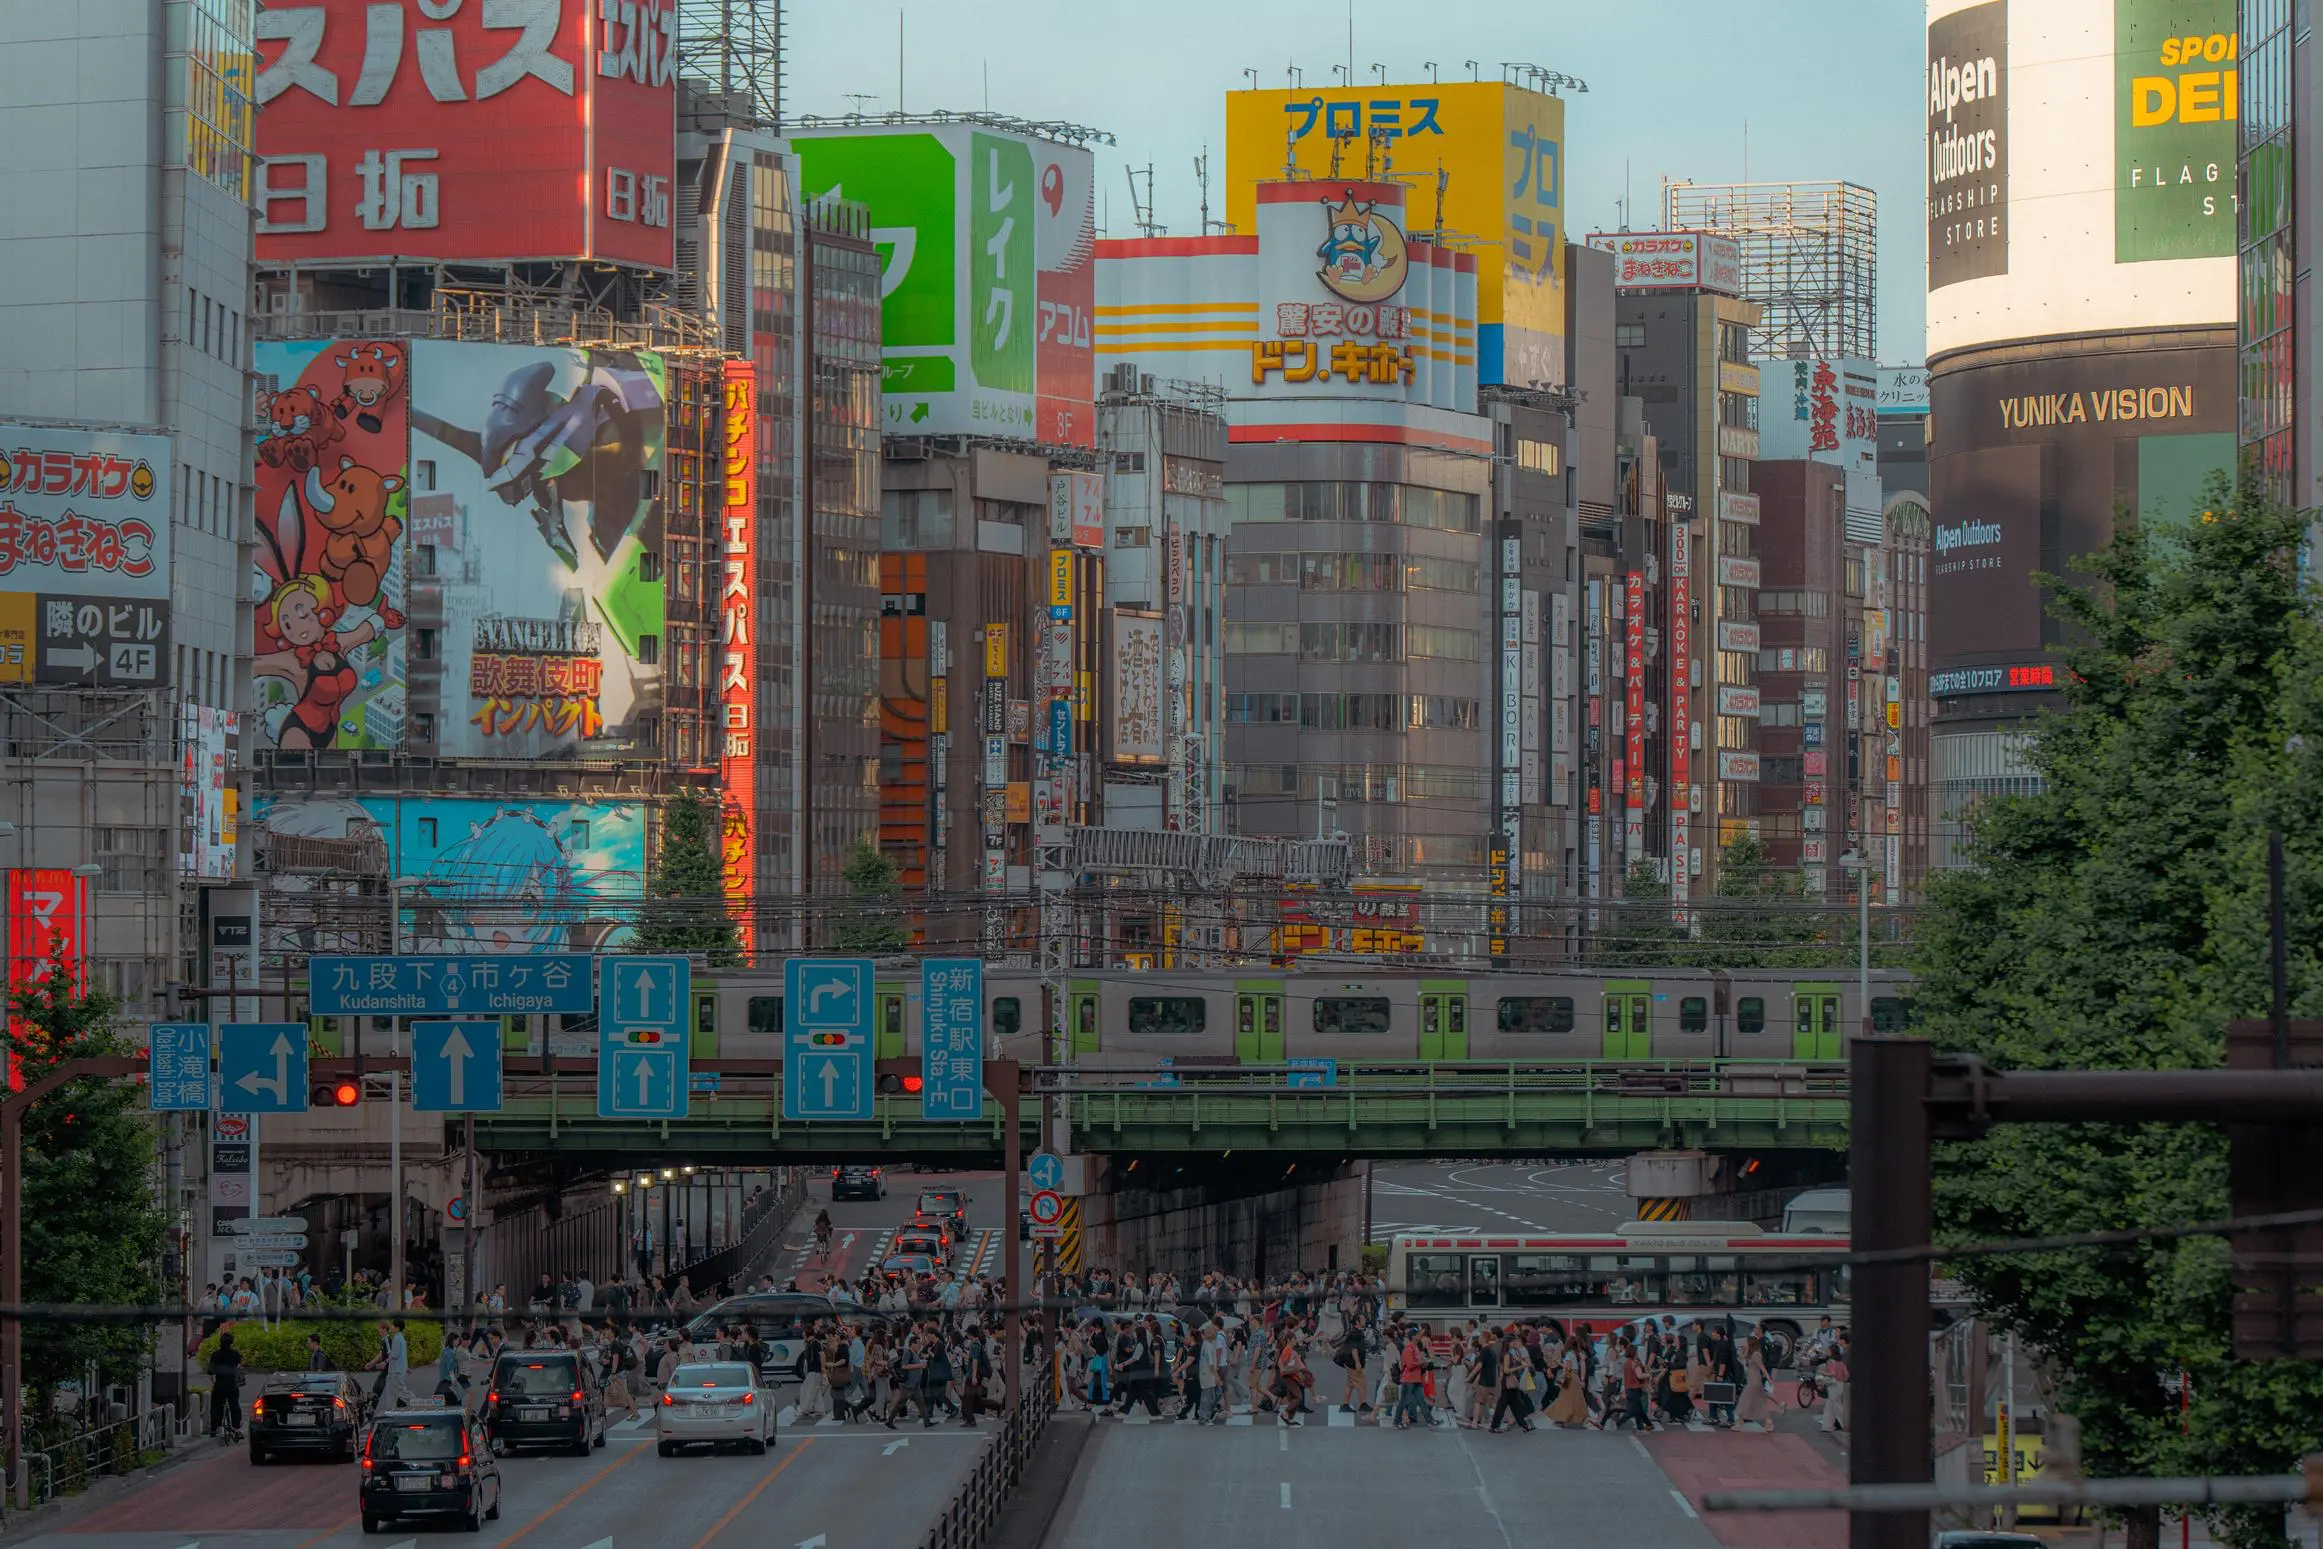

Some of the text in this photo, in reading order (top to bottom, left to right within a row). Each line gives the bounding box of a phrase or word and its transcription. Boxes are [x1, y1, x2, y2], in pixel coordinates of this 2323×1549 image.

[1930, 54, 1997, 122] Alpen
[1285, 96, 1445, 139] プロミス
[1933, 124, 1996, 185] Outdoors
[2132, 162, 2237, 188] FLAG
[257, 148, 439, 233] 日拓
[606, 166, 668, 228] 日拓
[1930, 183, 1999, 221] FLAGSHIP
[985, 148, 1015, 351] レイク
[1632, 239, 1683, 253] カラオケ
[1946, 216, 1998, 246] STORE
[1622, 258, 1693, 281] まねきねこ
[1039, 301, 1091, 348] アコム
[971, 399, 1023, 426] 当ビルとなり
[1057, 411, 1073, 439] 8F
[1809, 360, 1840, 449] 東海苑
[2000, 385, 2193, 429] YUNIKA VISION
[725, 380, 750, 506] パチンコ
[12, 449, 133, 499] カラオケ
[1056, 480, 1068, 533] 戸谷ビル
[0, 501, 156, 578] まねきねこ
[1935, 519, 2001, 557] Alpen Outdoors
[1057, 556, 1067, 600] プロミス
[1969, 556, 2002, 571] STORE
[46, 600, 162, 641] 隣のビル
[1055, 607, 1068, 617] 6F
[1675, 579, 1685, 669] KARAOKE
[115, 648, 151, 673] 4F
[472, 655, 602, 697] 歌舞伎町
[2009, 666, 2052, 688] 営業時間
[470, 697, 603, 737] インパクト
[994, 704, 1003, 731] STAND
[1506, 655, 1517, 764] KIBORI
[1675, 696, 1685, 759] PARTY
[988, 834, 1003, 847] 7F
[1675, 817, 1685, 922] PASELA
[332, 963, 435, 991] 九段下
[446, 979, 458, 993] 4
[340, 993, 553, 1010] Kudanshita Ichigaya
[928, 971, 947, 1043] Shinjuku
[949, 967, 975, 1110] 新宿駅東口
[154, 1027, 176, 1106] Otakibashi Brdg.
[177, 1030, 206, 1104] 小滝橋
